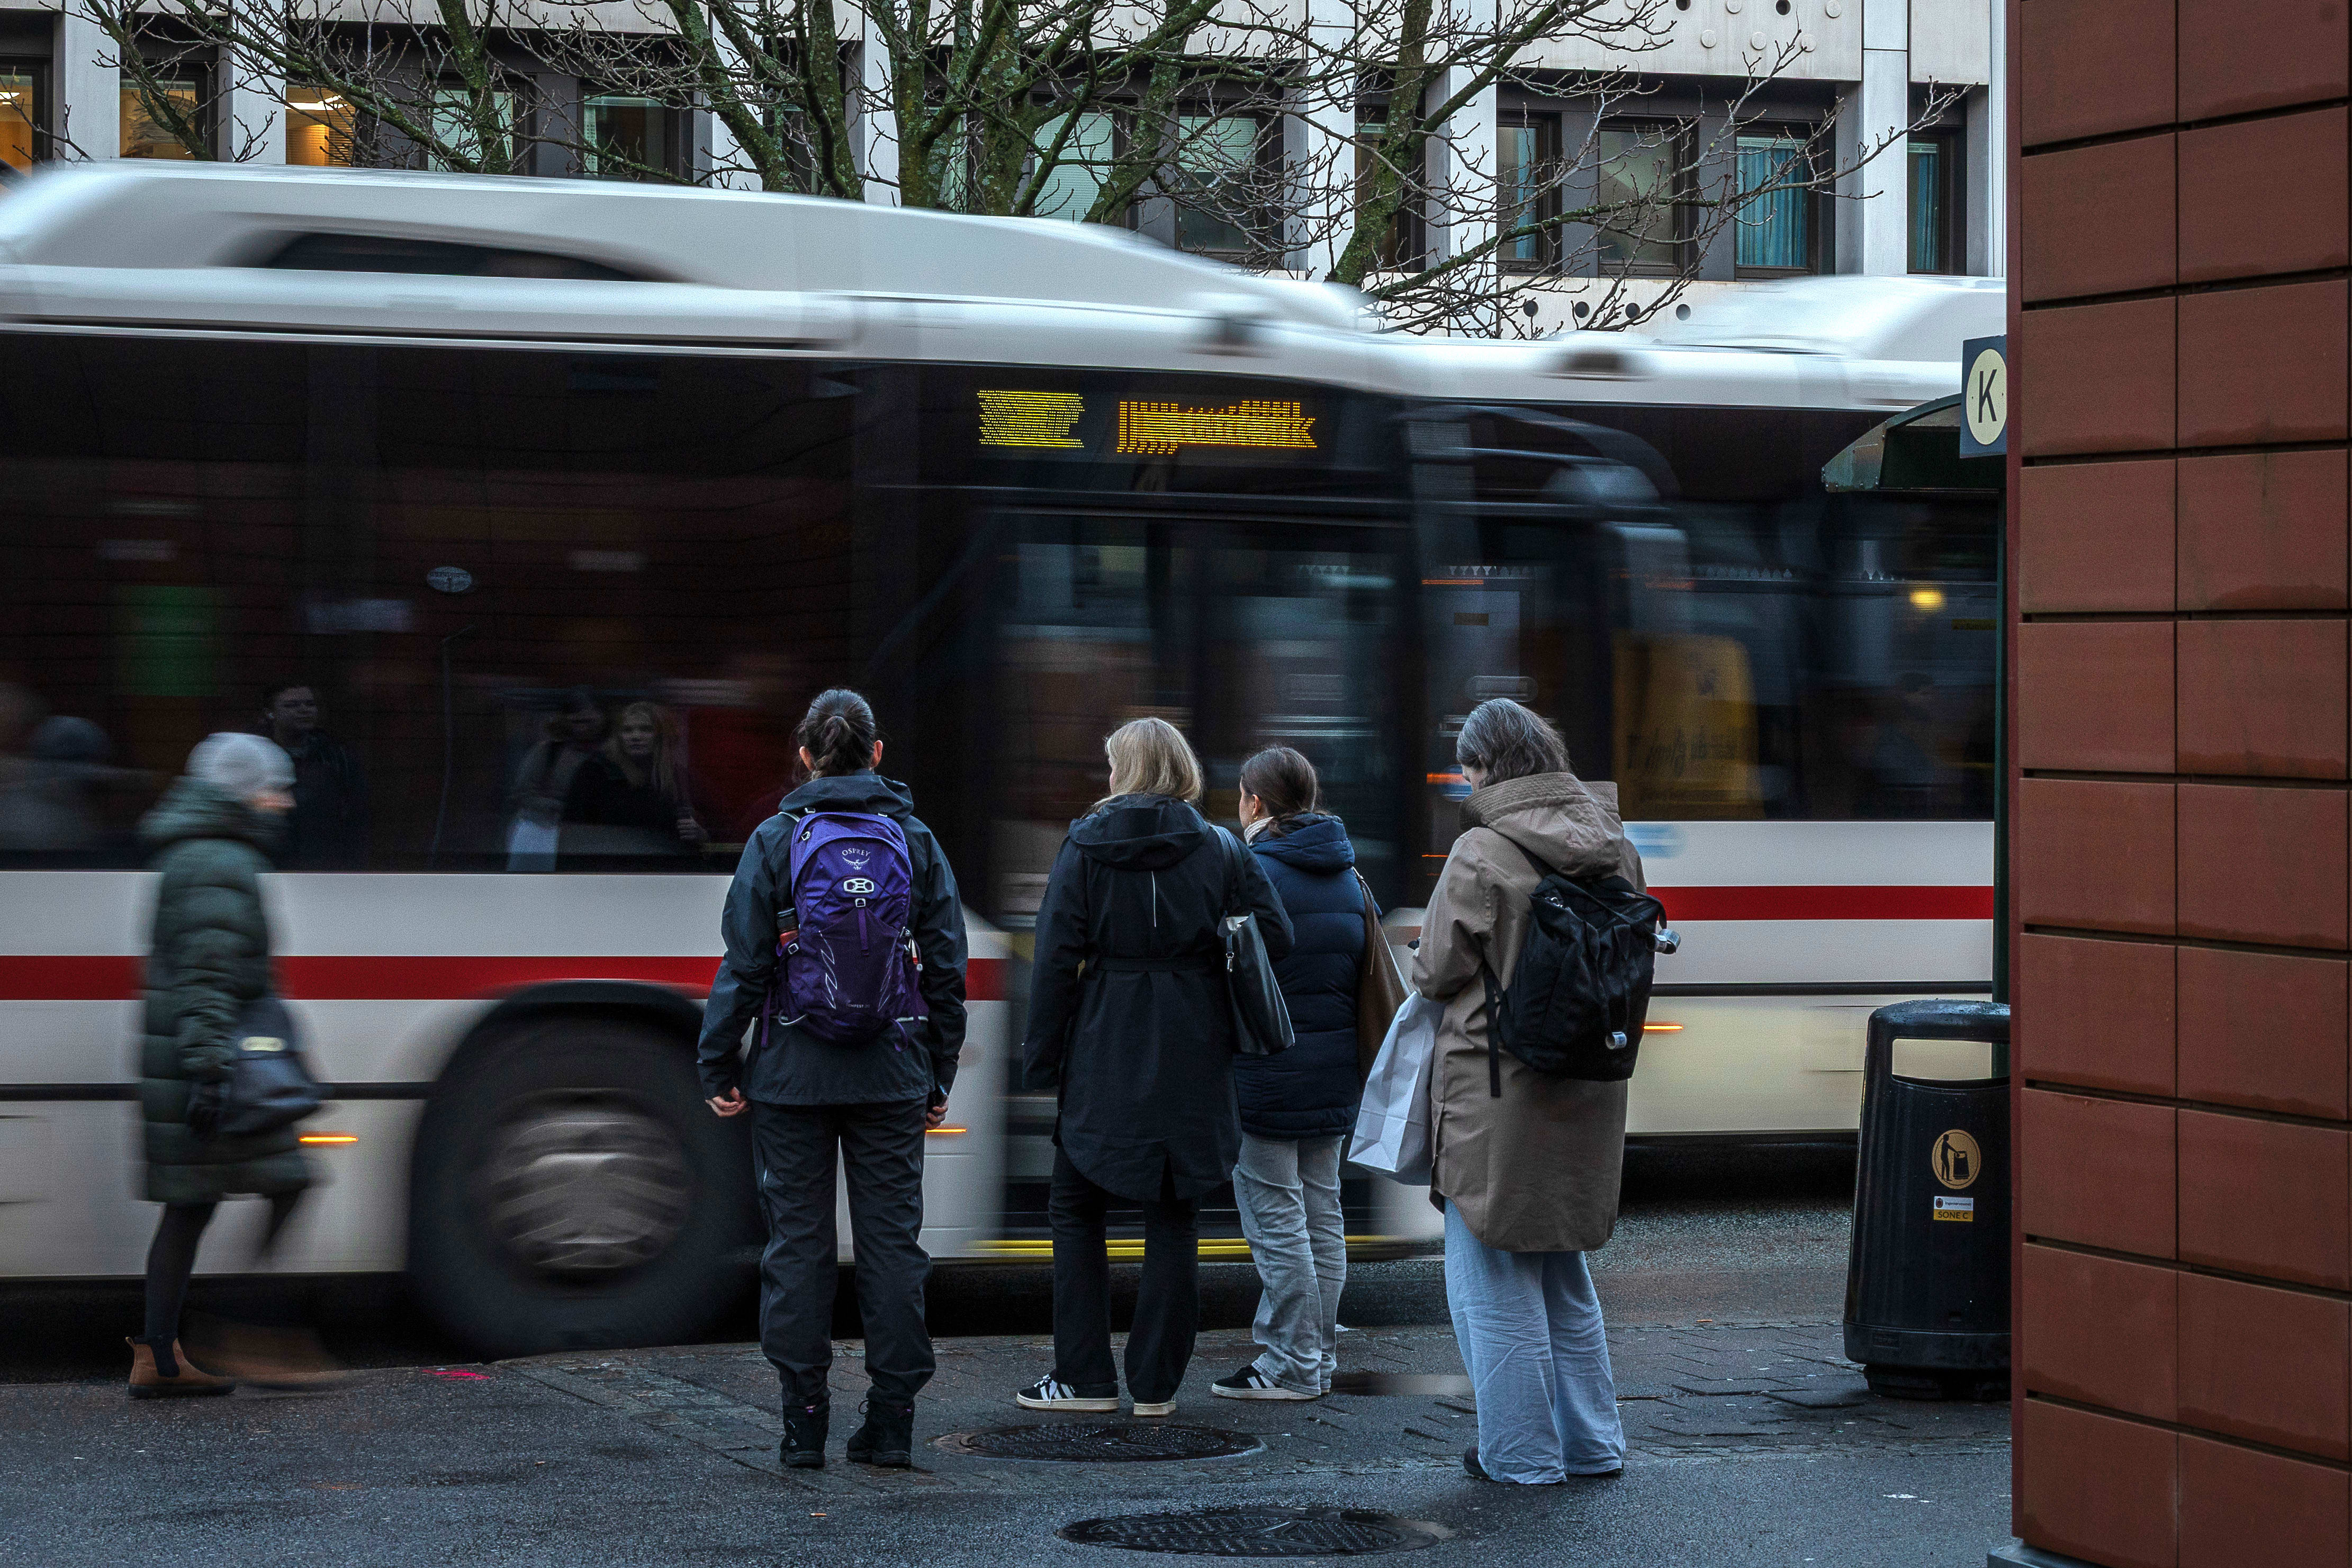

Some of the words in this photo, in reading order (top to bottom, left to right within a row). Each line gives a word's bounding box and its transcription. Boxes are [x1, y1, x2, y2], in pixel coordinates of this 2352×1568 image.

[1978, 368, 1997, 423] K
[842, 848, 871, 857] OSPREY
[1938, 1211, 1961, 1219] SONE
